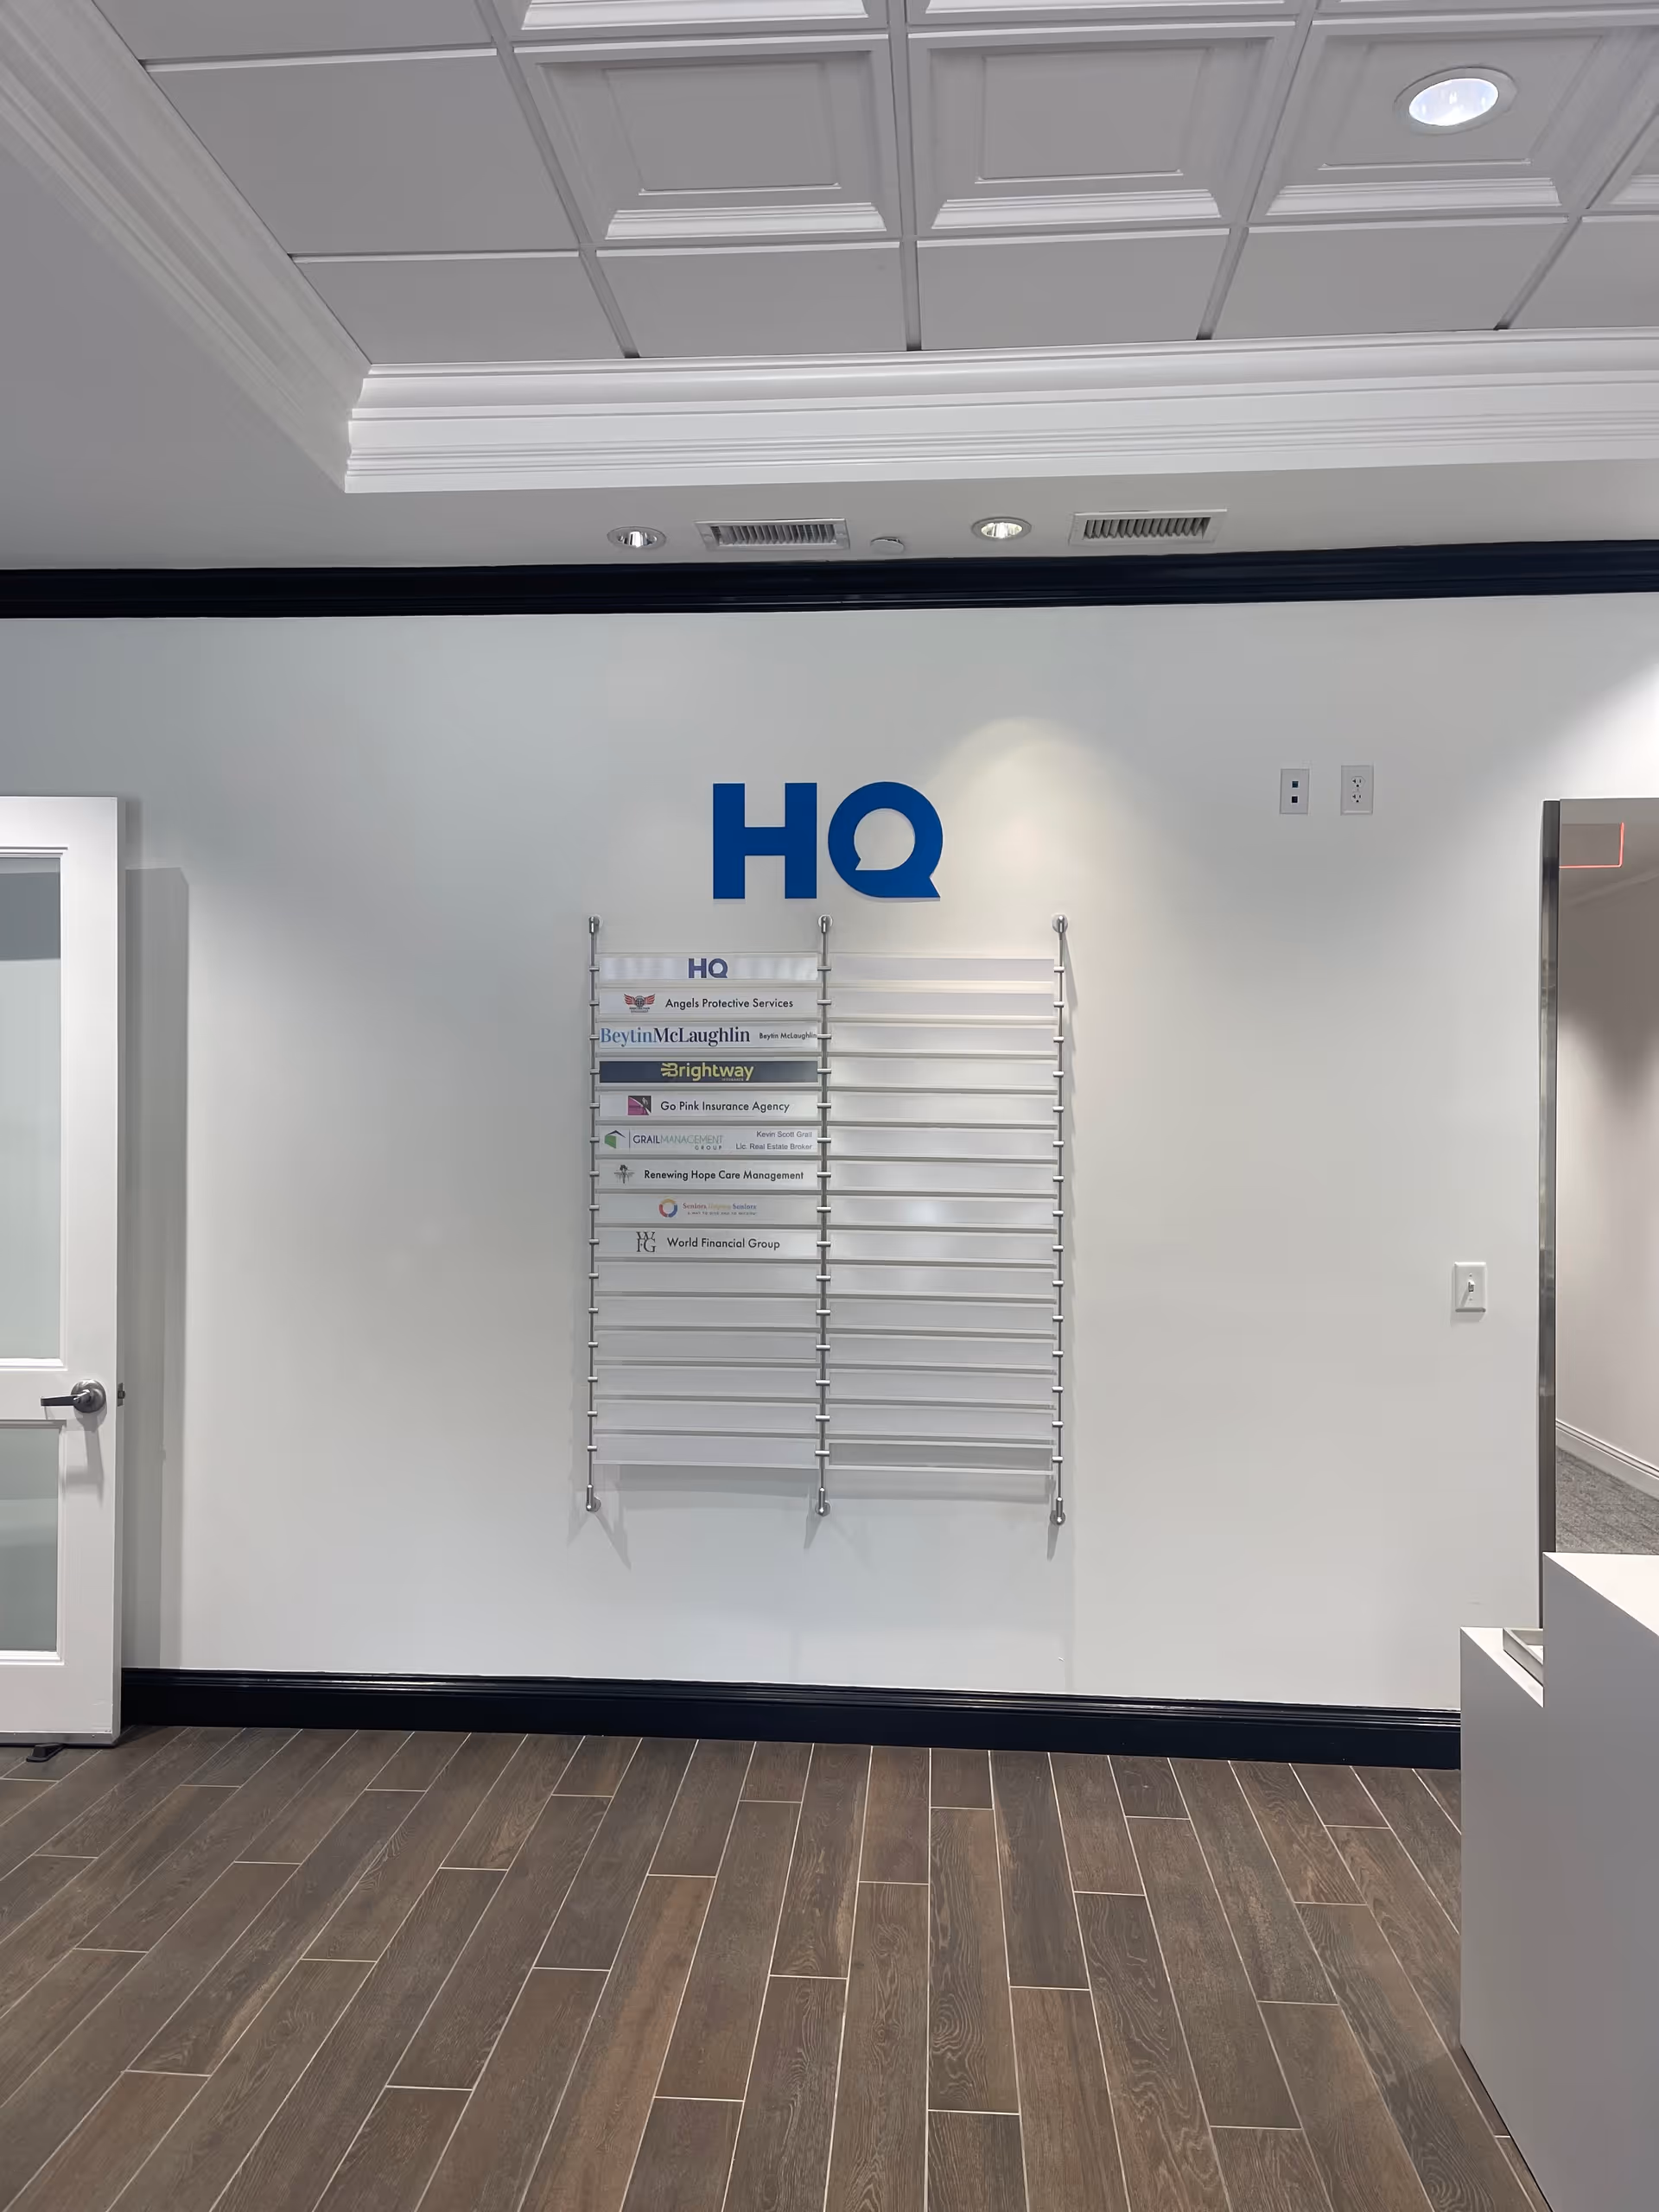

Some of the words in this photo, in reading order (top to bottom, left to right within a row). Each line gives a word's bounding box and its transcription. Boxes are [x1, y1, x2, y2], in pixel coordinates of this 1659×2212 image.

[713, 781, 943, 899] HQ
[689, 958, 728, 978] HQ
[665, 998, 699, 1010] Angels
[702, 998, 749, 1007] Protective
[753, 999, 793, 1007] Services
[601, 1027, 750, 1046] BeytinMcLaughlin
[661, 1062, 753, 1081] Brightway
[660, 1101, 676, 1110] Go
[680, 1101, 699, 1110] Pink
[702, 1102, 749, 1110] Insurance
[752, 1102, 790, 1113] Agency
[645, 1170, 688, 1181] Renewing
[691, 1170, 715, 1181] Hope
[719, 1171, 740, 1179] Care
[743, 1171, 804, 1181] Management
[667, 1237, 697, 1248] World
[702, 1238, 745, 1248] Financial
[748, 1239, 780, 1250] Group
